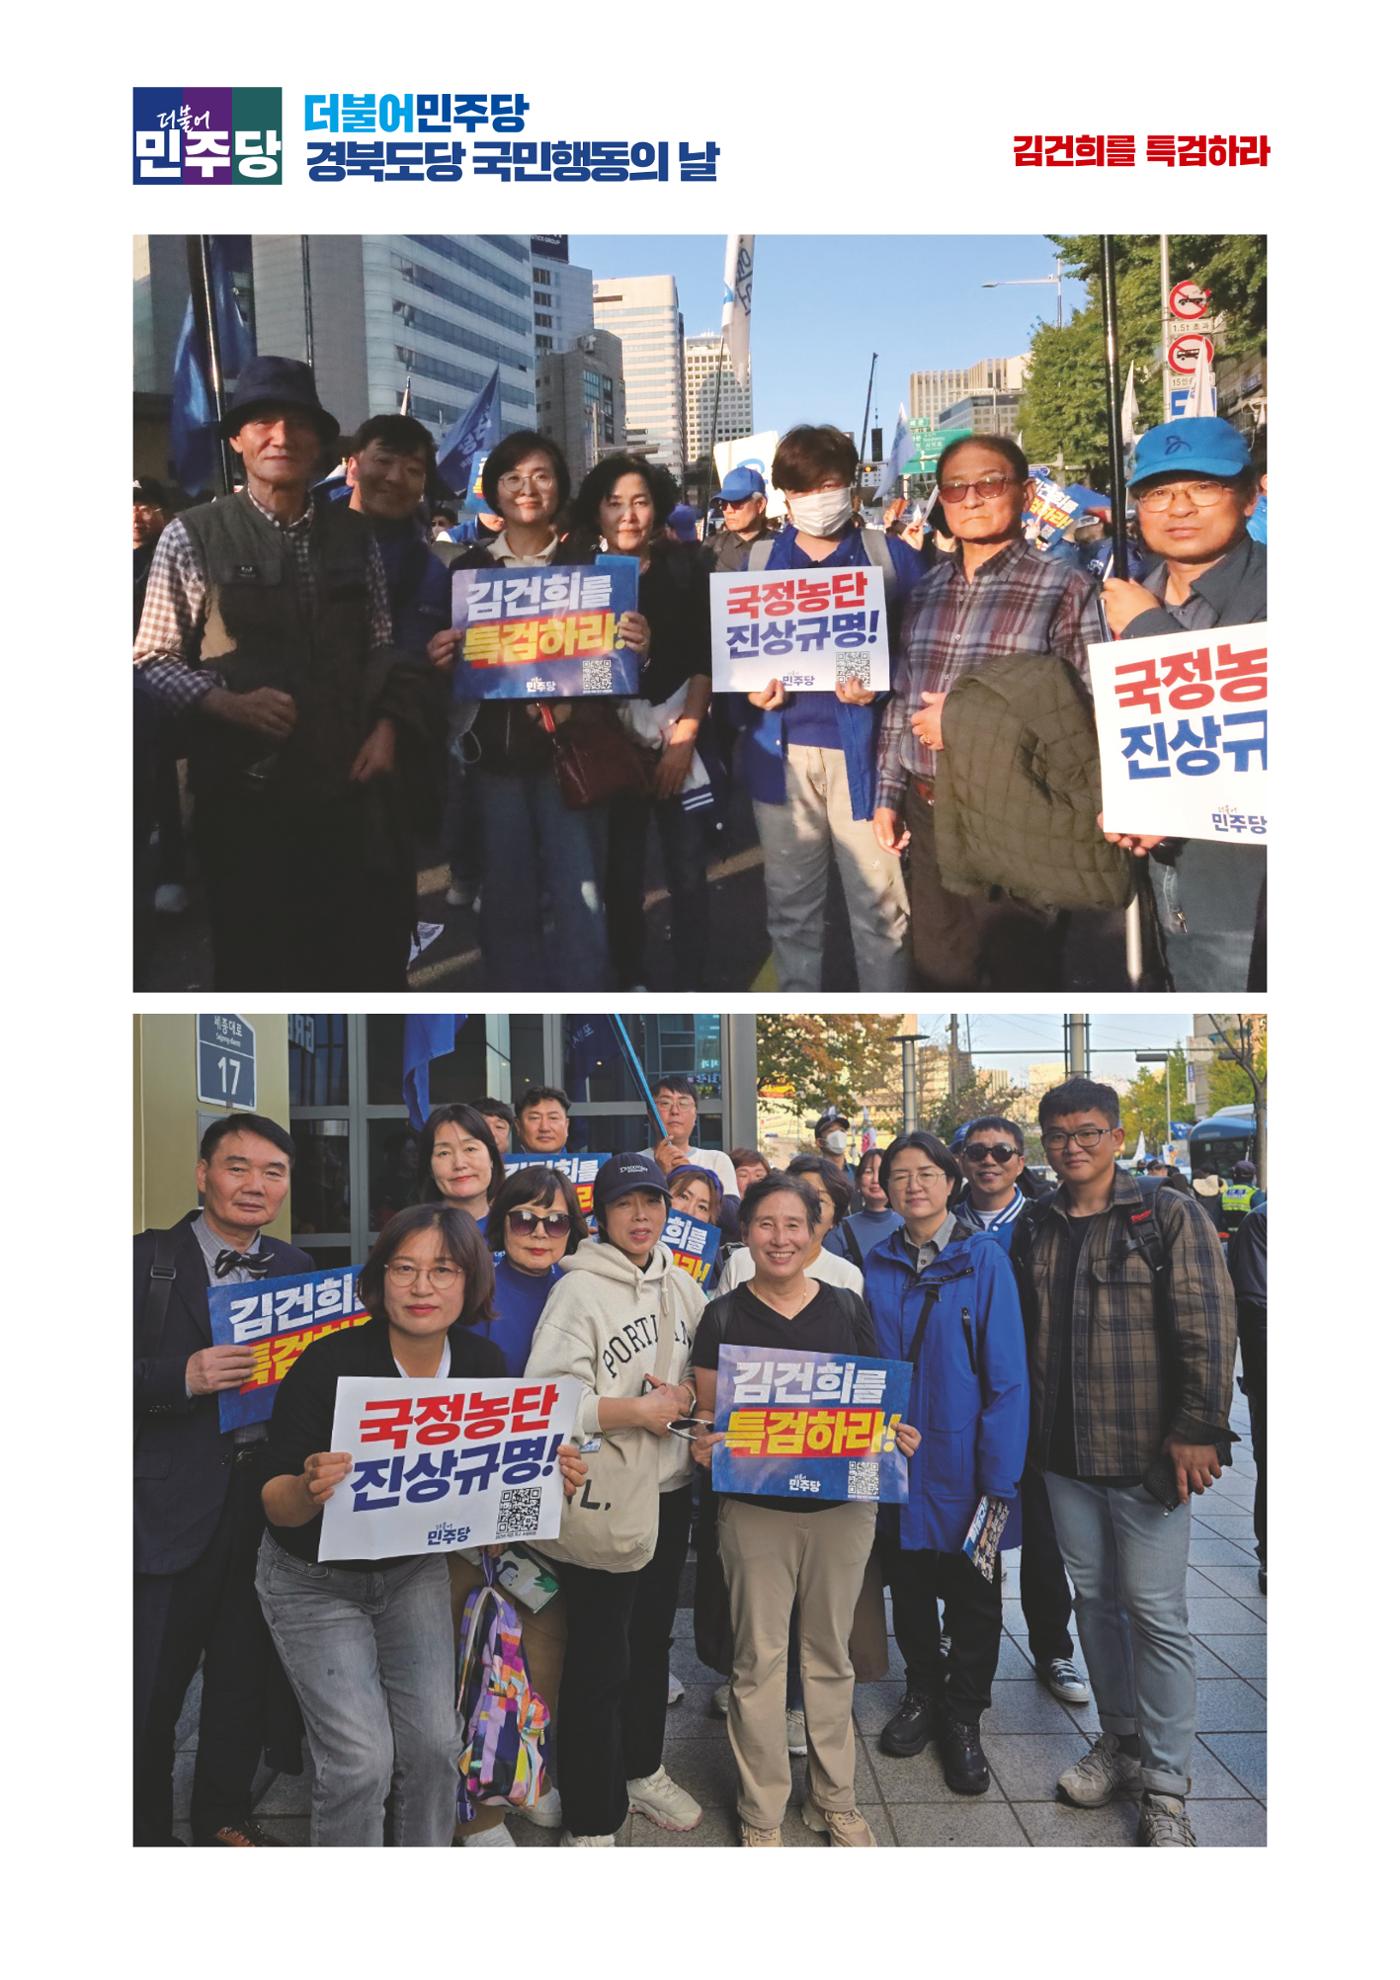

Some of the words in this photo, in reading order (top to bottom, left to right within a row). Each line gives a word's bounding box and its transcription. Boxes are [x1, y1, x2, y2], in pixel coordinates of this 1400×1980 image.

[466, 572, 613, 622] 김건희를
[726, 571, 868, 619] 국정농단
[463, 613, 629, 665] 특검하라!
[726, 610, 879, 660] 진상규명!
[526, 680, 556, 693] 민주당
[782, 675, 815, 687] 민주당
[1211, 813, 1267, 834] 민주당
[218, 1056, 240, 1095] 17
[229, 1273, 366, 1344] 김건희
[733, 1361, 887, 1404] 김건희를
[359, 1384, 559, 1449] 국정농단
[724, 1411, 902, 1455] 특검하라!
[350, 1433, 564, 1512] 진상규명!
[789, 1479, 821, 1492] 민주당
[427, 1526, 471, 1545] 민주당
